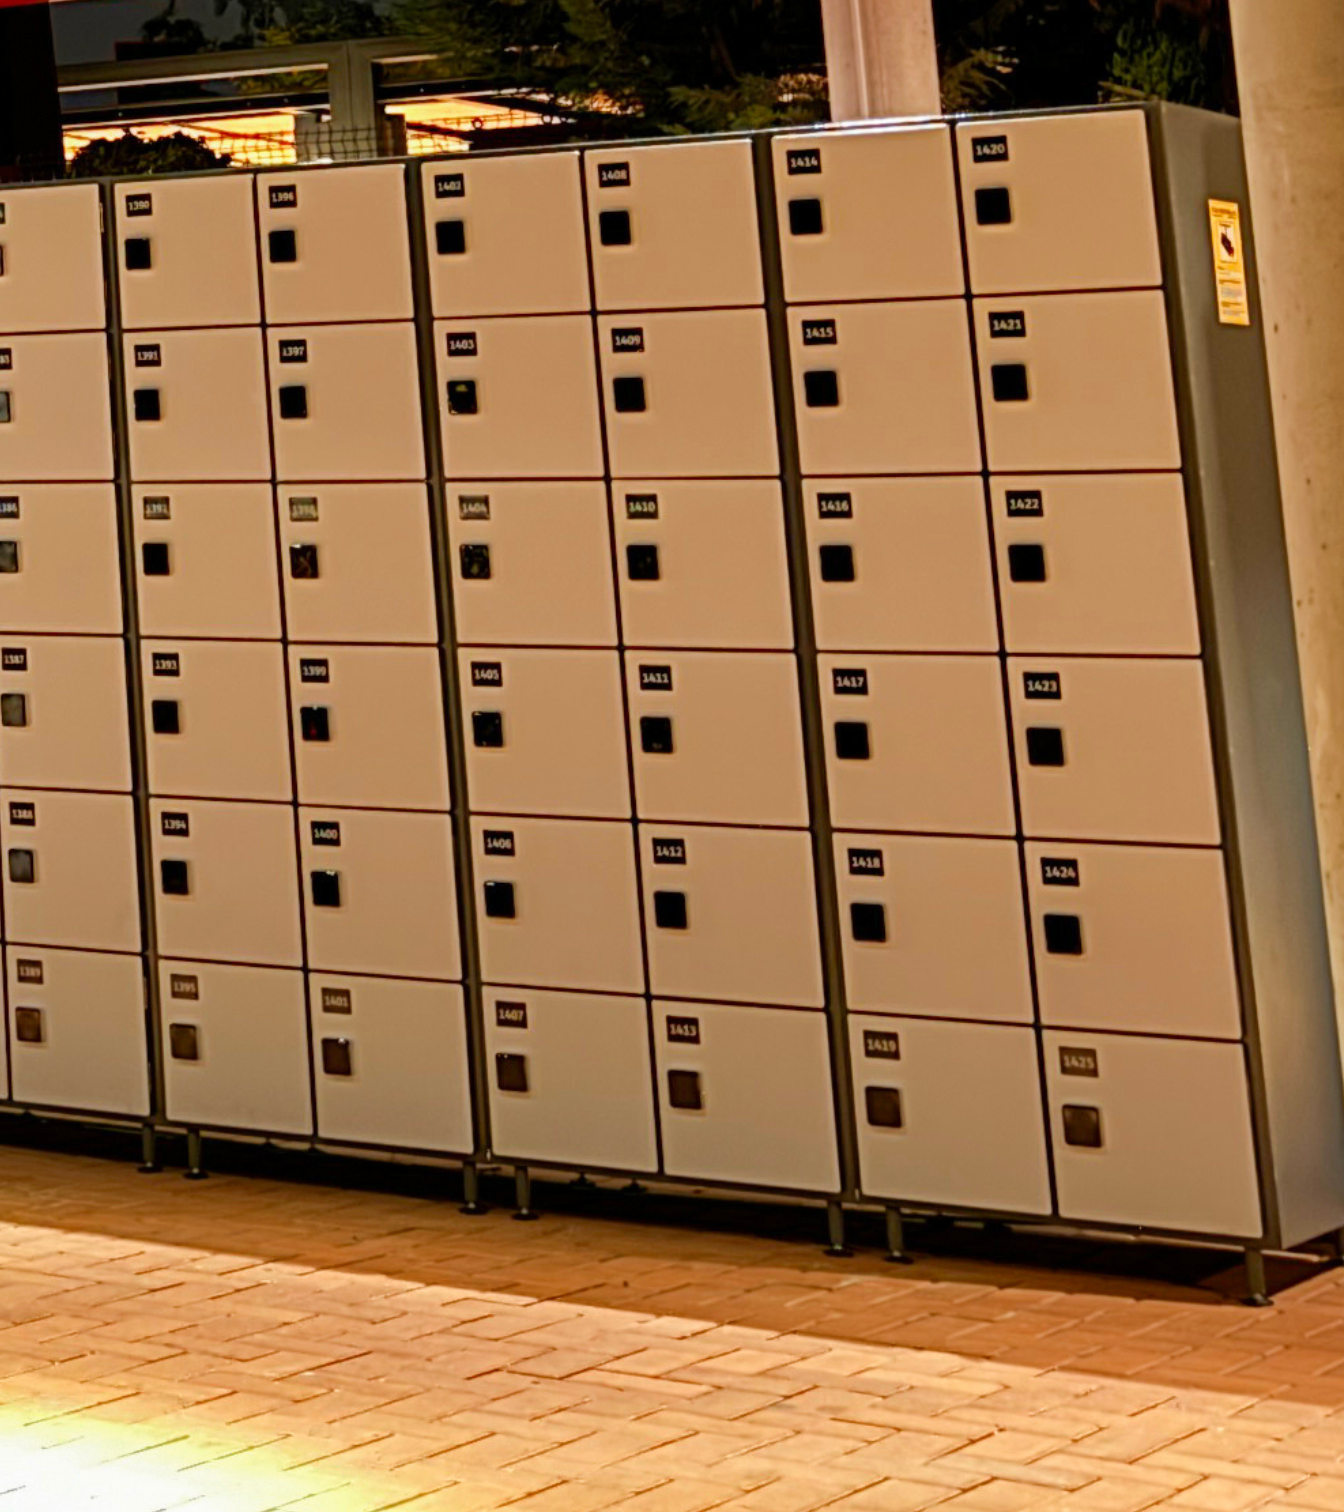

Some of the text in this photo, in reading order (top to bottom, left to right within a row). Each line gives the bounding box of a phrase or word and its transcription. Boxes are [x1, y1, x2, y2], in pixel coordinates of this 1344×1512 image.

[976, 143, 1006, 156] 1420
[790, 156, 818, 168] 1414
[601, 169, 628, 181] 1408
[438, 180, 462, 192] 1402
[271, 191, 295, 203] 1396
[128, 200, 150, 211] 1390
[993, 318, 1022, 331] 1421
[805, 326, 834, 339] 1415
[450, 339, 475, 350] 1403
[615, 334, 641, 346] 1409
[137, 351, 158, 361] 1391
[282, 346, 305, 357] 1397
[460, 502, 488, 514] 1404
[629, 501, 656, 513] 1410
[820, 500, 850, 512] 1416
[1010, 498, 1039, 510] 1422
[4, 654, 25, 665] 1387
[155, 659, 177, 670] 1393
[303, 665, 327, 677] 1399
[474, 668, 500, 680] 1405
[642, 672, 669, 684] 1411
[836, 676, 864, 688] 1417
[1027, 680, 1058, 692] 1423
[164, 819, 187, 830] 1394
[314, 828, 338, 840] 1400
[487, 837, 512, 849] 1406
[656, 845, 683, 858] 1412
[852, 856, 881, 869] 1418
[1045, 866, 1076, 879] 1424
[324, 995, 348, 1007] 1401
[499, 1008, 524, 1021] 1407
[669, 1023, 697, 1037] 1413
[867, 1038, 897, 1052] 1419
[1063, 1055, 1095, 1069] 1425
